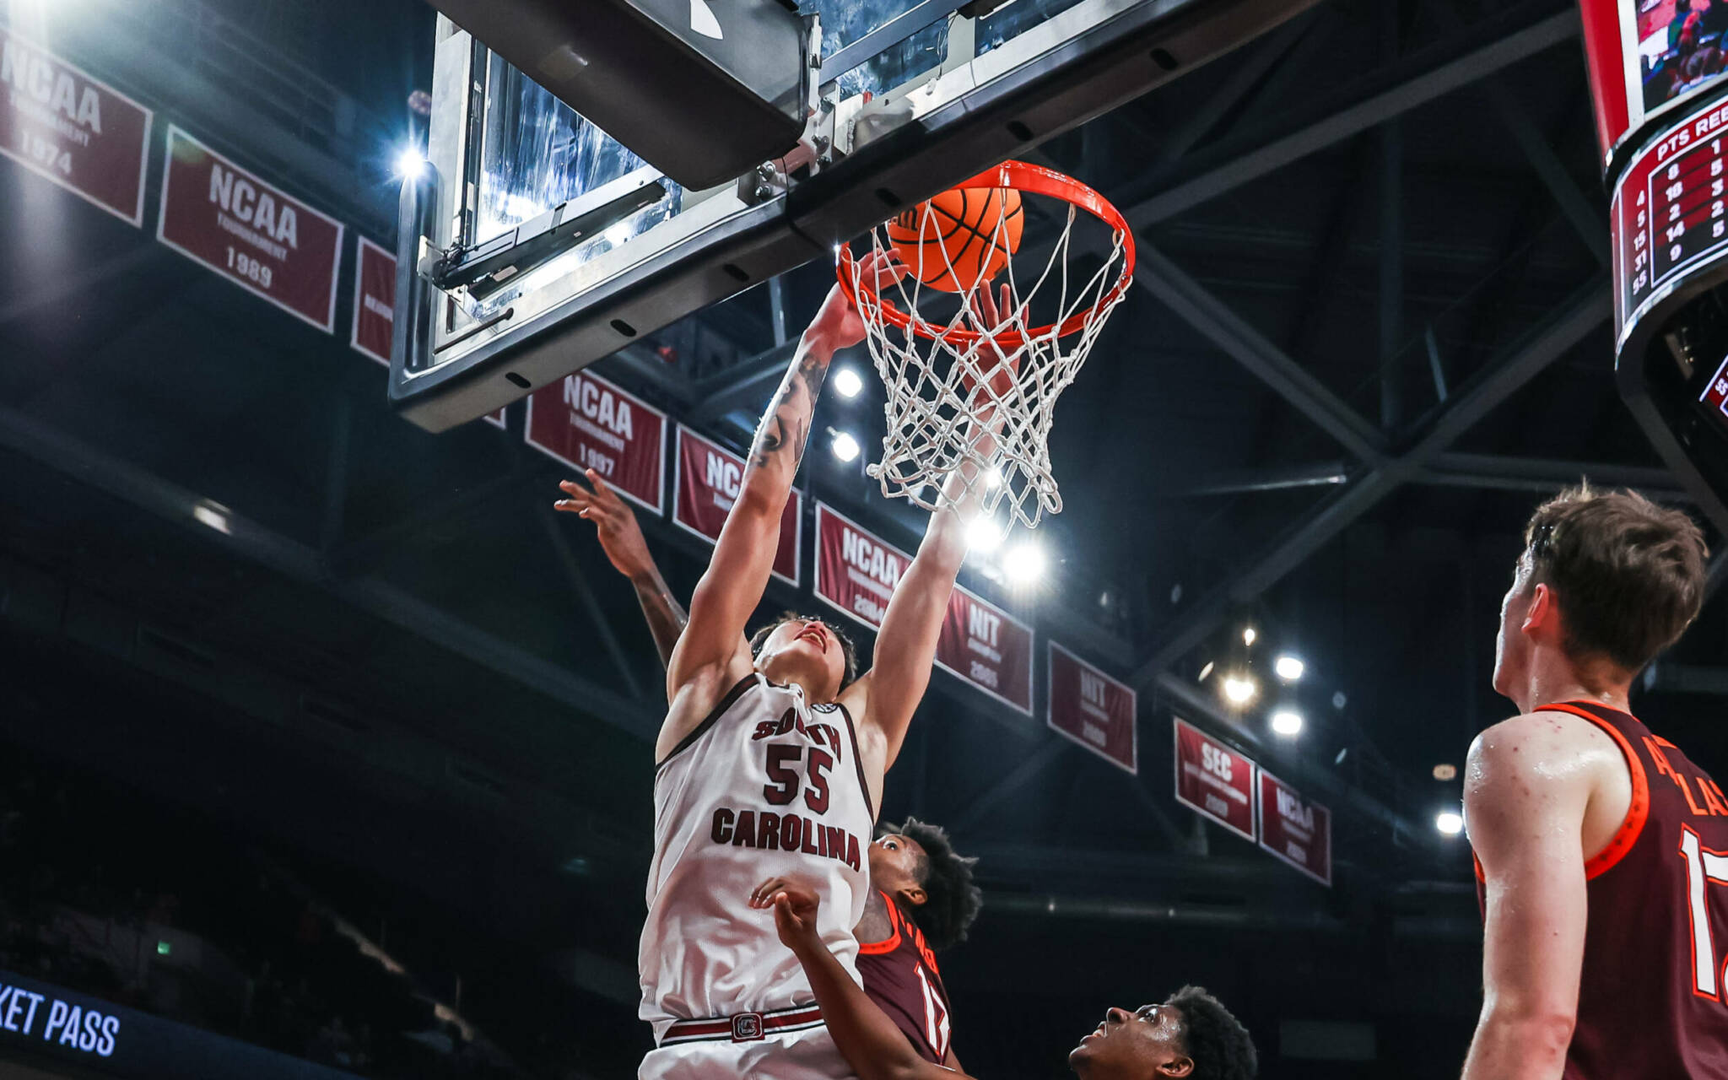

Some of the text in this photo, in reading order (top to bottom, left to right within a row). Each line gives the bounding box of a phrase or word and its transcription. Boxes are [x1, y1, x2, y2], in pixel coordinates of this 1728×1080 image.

[1, 40, 102, 135] NCAA
[21, 130, 72, 174] 1974
[1636, 190, 1645, 206] 4
[1711, 139, 1721, 154] 1
[1656, 129, 1690, 161] PTS
[209, 163, 297, 249] NCAA
[1634, 179, 1724, 251] 15 2 3
[1637, 159, 1723, 227] 5 18 5
[1633, 220, 1725, 295] 55 9 5
[1635, 201, 1724, 271] 31 14 2
[227, 246, 272, 288] 1989
[563, 375, 633, 441] NCAA
[579, 442, 615, 477] 1997
[706, 451, 741, 499] NC
[842, 527, 900, 588] NCAA
[969, 603, 1000, 647] NIT
[1080, 669, 1106, 708] NIT
[763, 744, 833, 816] 55
[1202, 742, 1233, 782] SEC
[710, 807, 861, 873] CAROLINA
[1276, 786, 1315, 833] NCAA
[44, 999, 120, 1056] PASS
